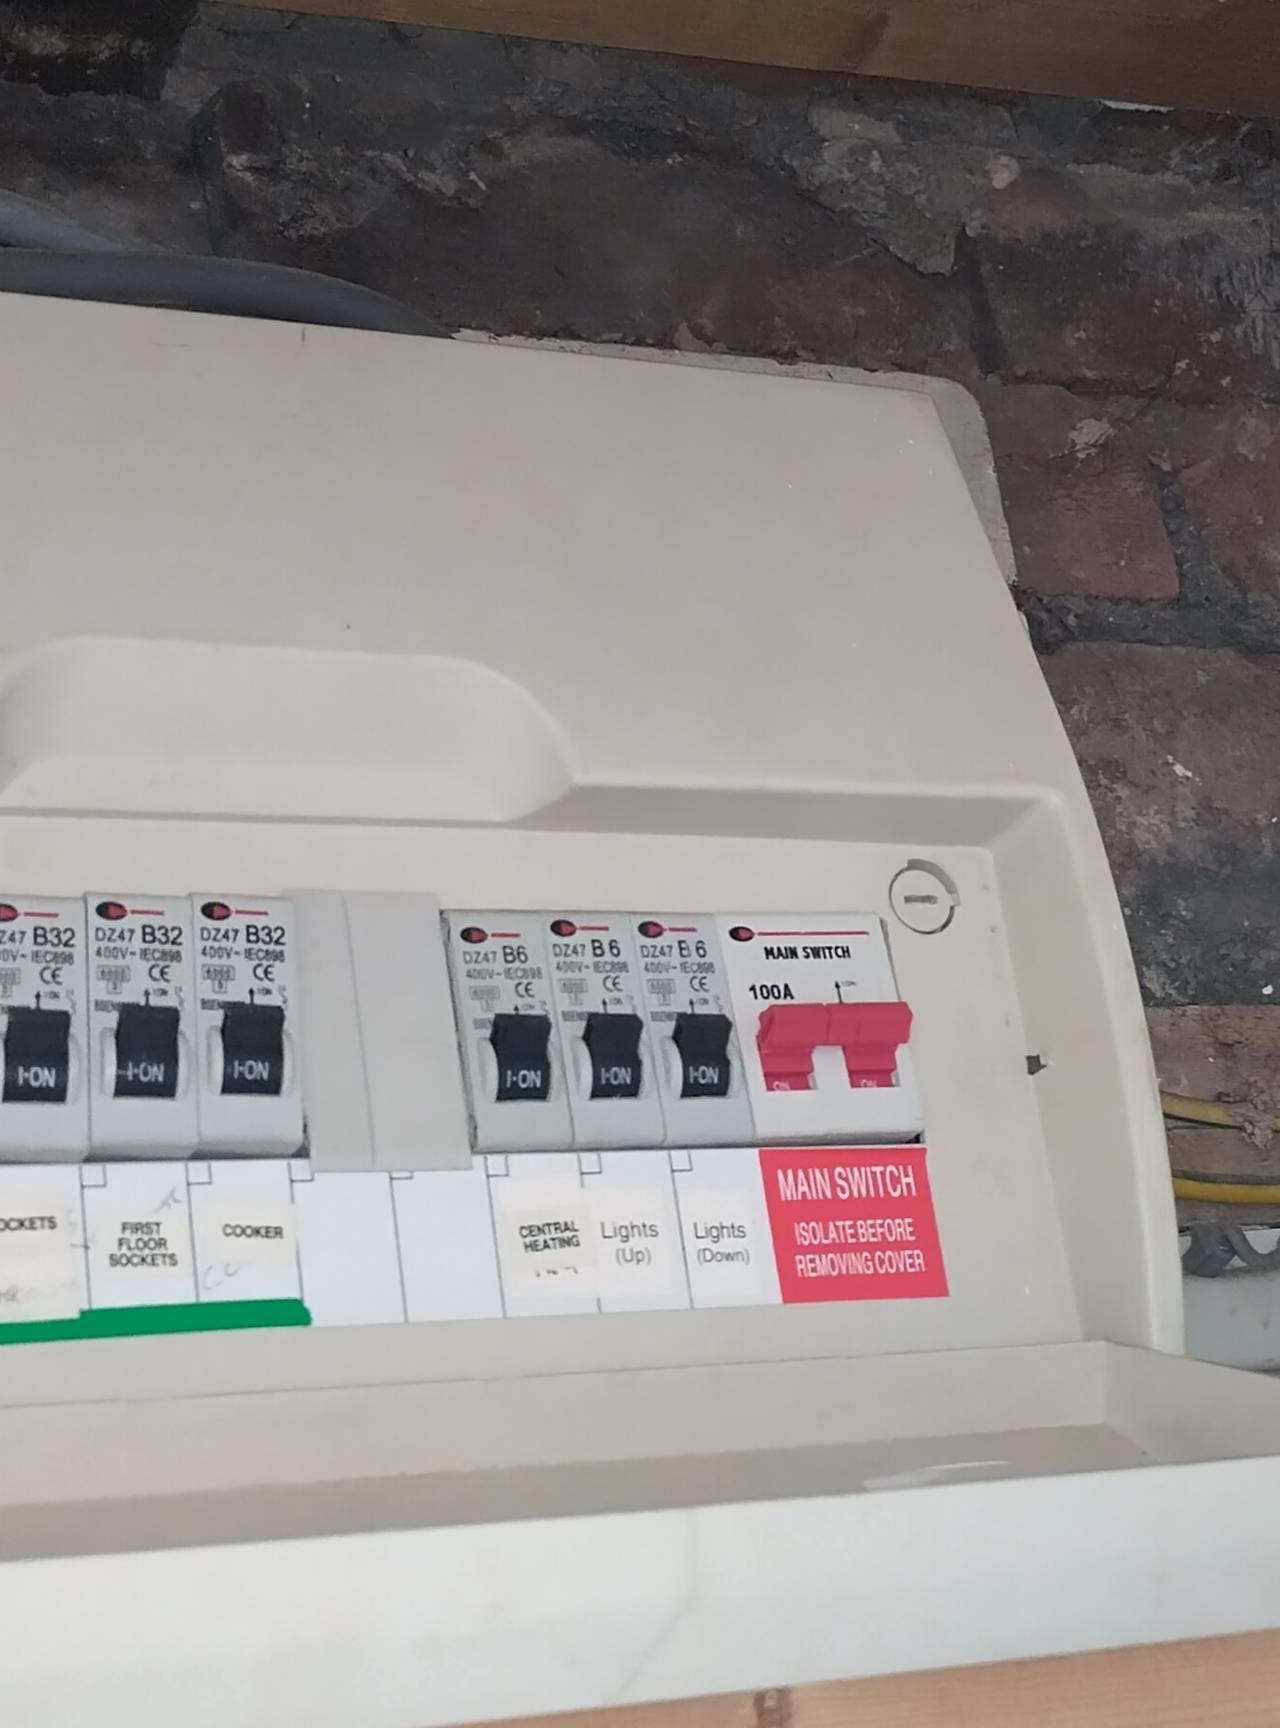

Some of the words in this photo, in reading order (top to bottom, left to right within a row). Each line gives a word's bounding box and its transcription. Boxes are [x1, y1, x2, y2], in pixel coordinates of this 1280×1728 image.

[32, 926, 75, 947] B32
[95, 927, 135, 943] DZ47
[141, 925, 183, 946] B32
[200, 927, 239, 943] DZ47
[245, 925, 286, 946] B32
[462, 950, 497, 964] DZ47
[502, 945, 528, 964] B6
[553, 943, 586, 958] DZ47
[641, 944, 673, 958] DZ47
[764, 946, 800, 960] MAIN
[803, 945, 851, 960] SWITCH
[748, 983, 794, 1000] 100A
[777, 1168, 833, 1201] MAIN
[834, 1164, 917, 1200] SWITCH
[121, 1222, 162, 1236] FIRST
[222, 1224, 284, 1239] COOKER
[519, 1220, 580, 1239] CENTRAL
[600, 1221, 659, 1243] Lights
[693, 1222, 747, 1243] Lights
[794, 1219, 855, 1245] ISOLATE
[856, 1217, 916, 1243] BEFORE
[118, 1237, 168, 1252] FLOOR
[523, 1235, 581, 1253] HEATING
[109, 1253, 178, 1268] SOCKETS
[615, 1248, 652, 1265] (Up)
[696, 1247, 751, 1266] (Down)
[795, 1251, 875, 1278] REMOVING
[875, 1249, 926, 1275] COVER
